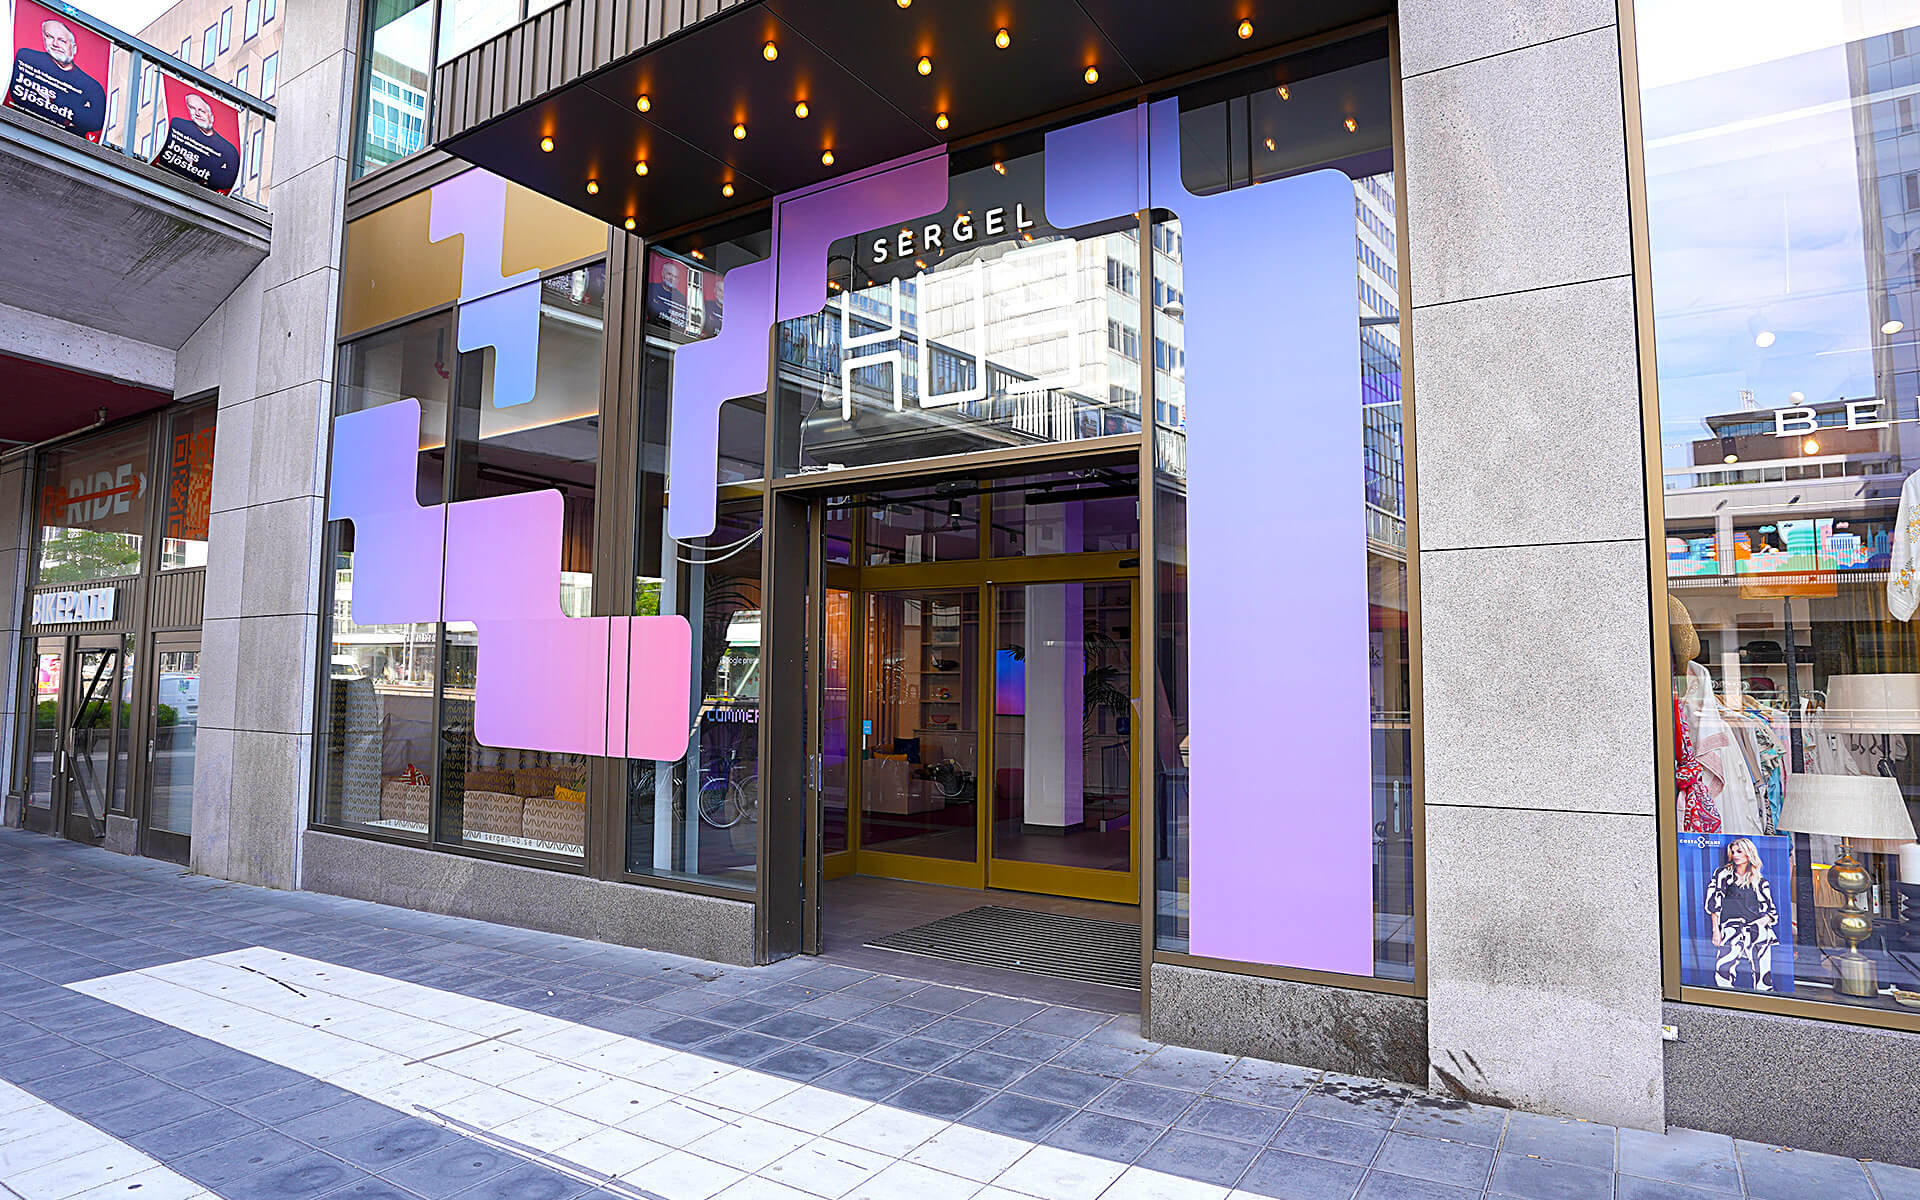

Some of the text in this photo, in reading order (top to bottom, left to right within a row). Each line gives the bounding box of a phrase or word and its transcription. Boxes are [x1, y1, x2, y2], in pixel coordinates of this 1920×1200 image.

[12, 84, 74, 120] Sjöstedt
[15, 73, 57, 99] Jonas
[162, 150, 211, 180] Sjöstedt
[168, 140, 200, 163] Jonas
[872, 203, 1034, 264] SERGEL
[1774, 395, 1920, 438] BE
[32, 587, 116, 625] BIKEPATH
